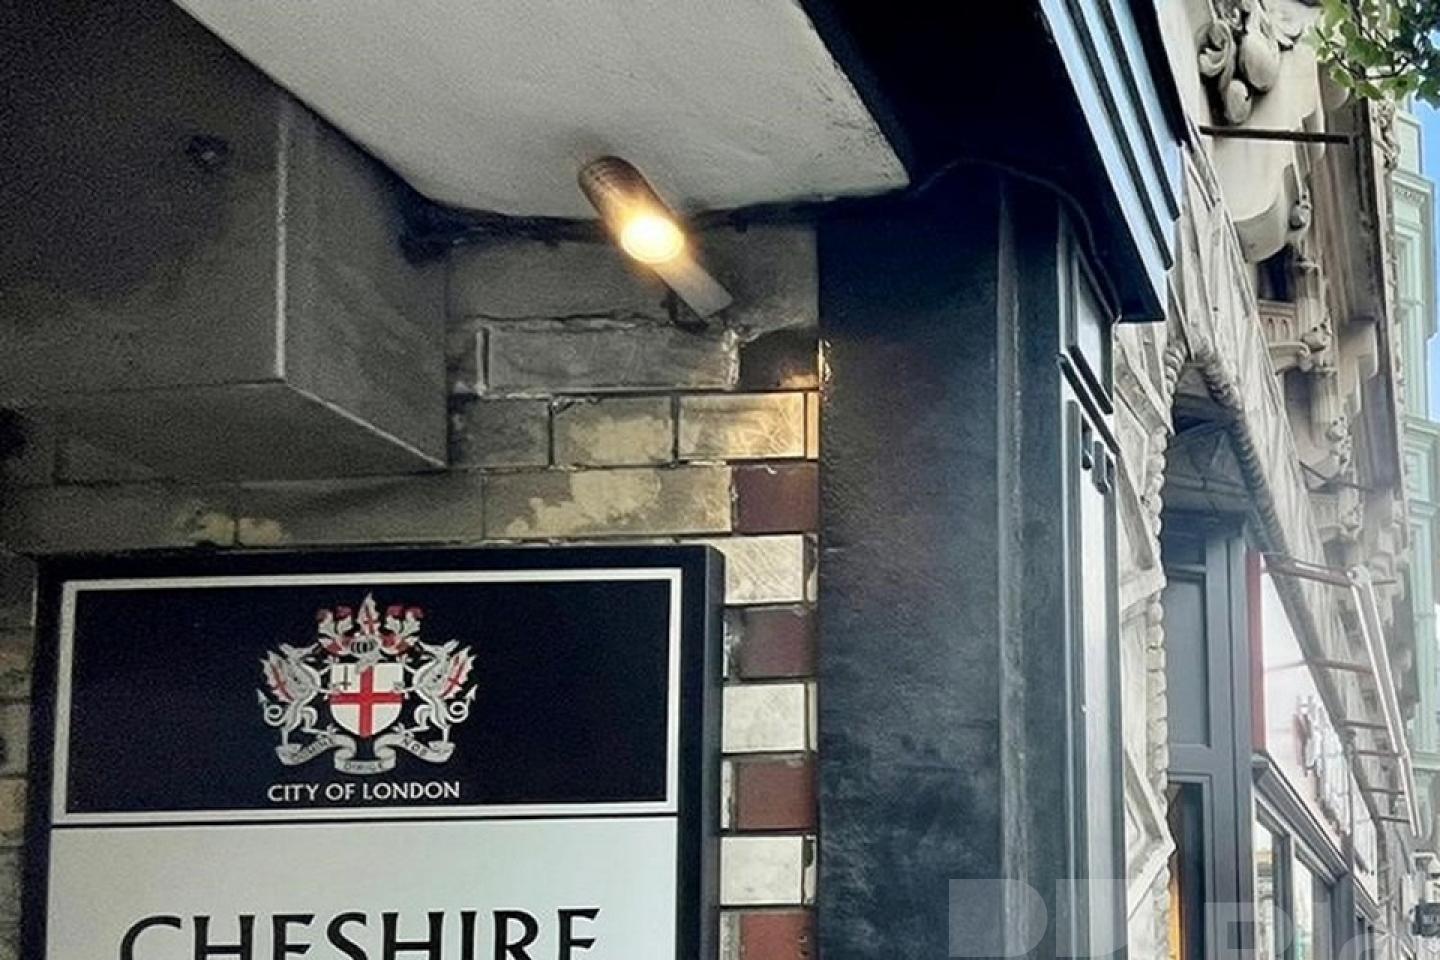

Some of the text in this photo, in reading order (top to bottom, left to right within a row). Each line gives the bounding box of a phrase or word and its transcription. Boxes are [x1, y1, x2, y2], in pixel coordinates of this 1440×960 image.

[267, 781, 461, 803] CITY OF LONDON
